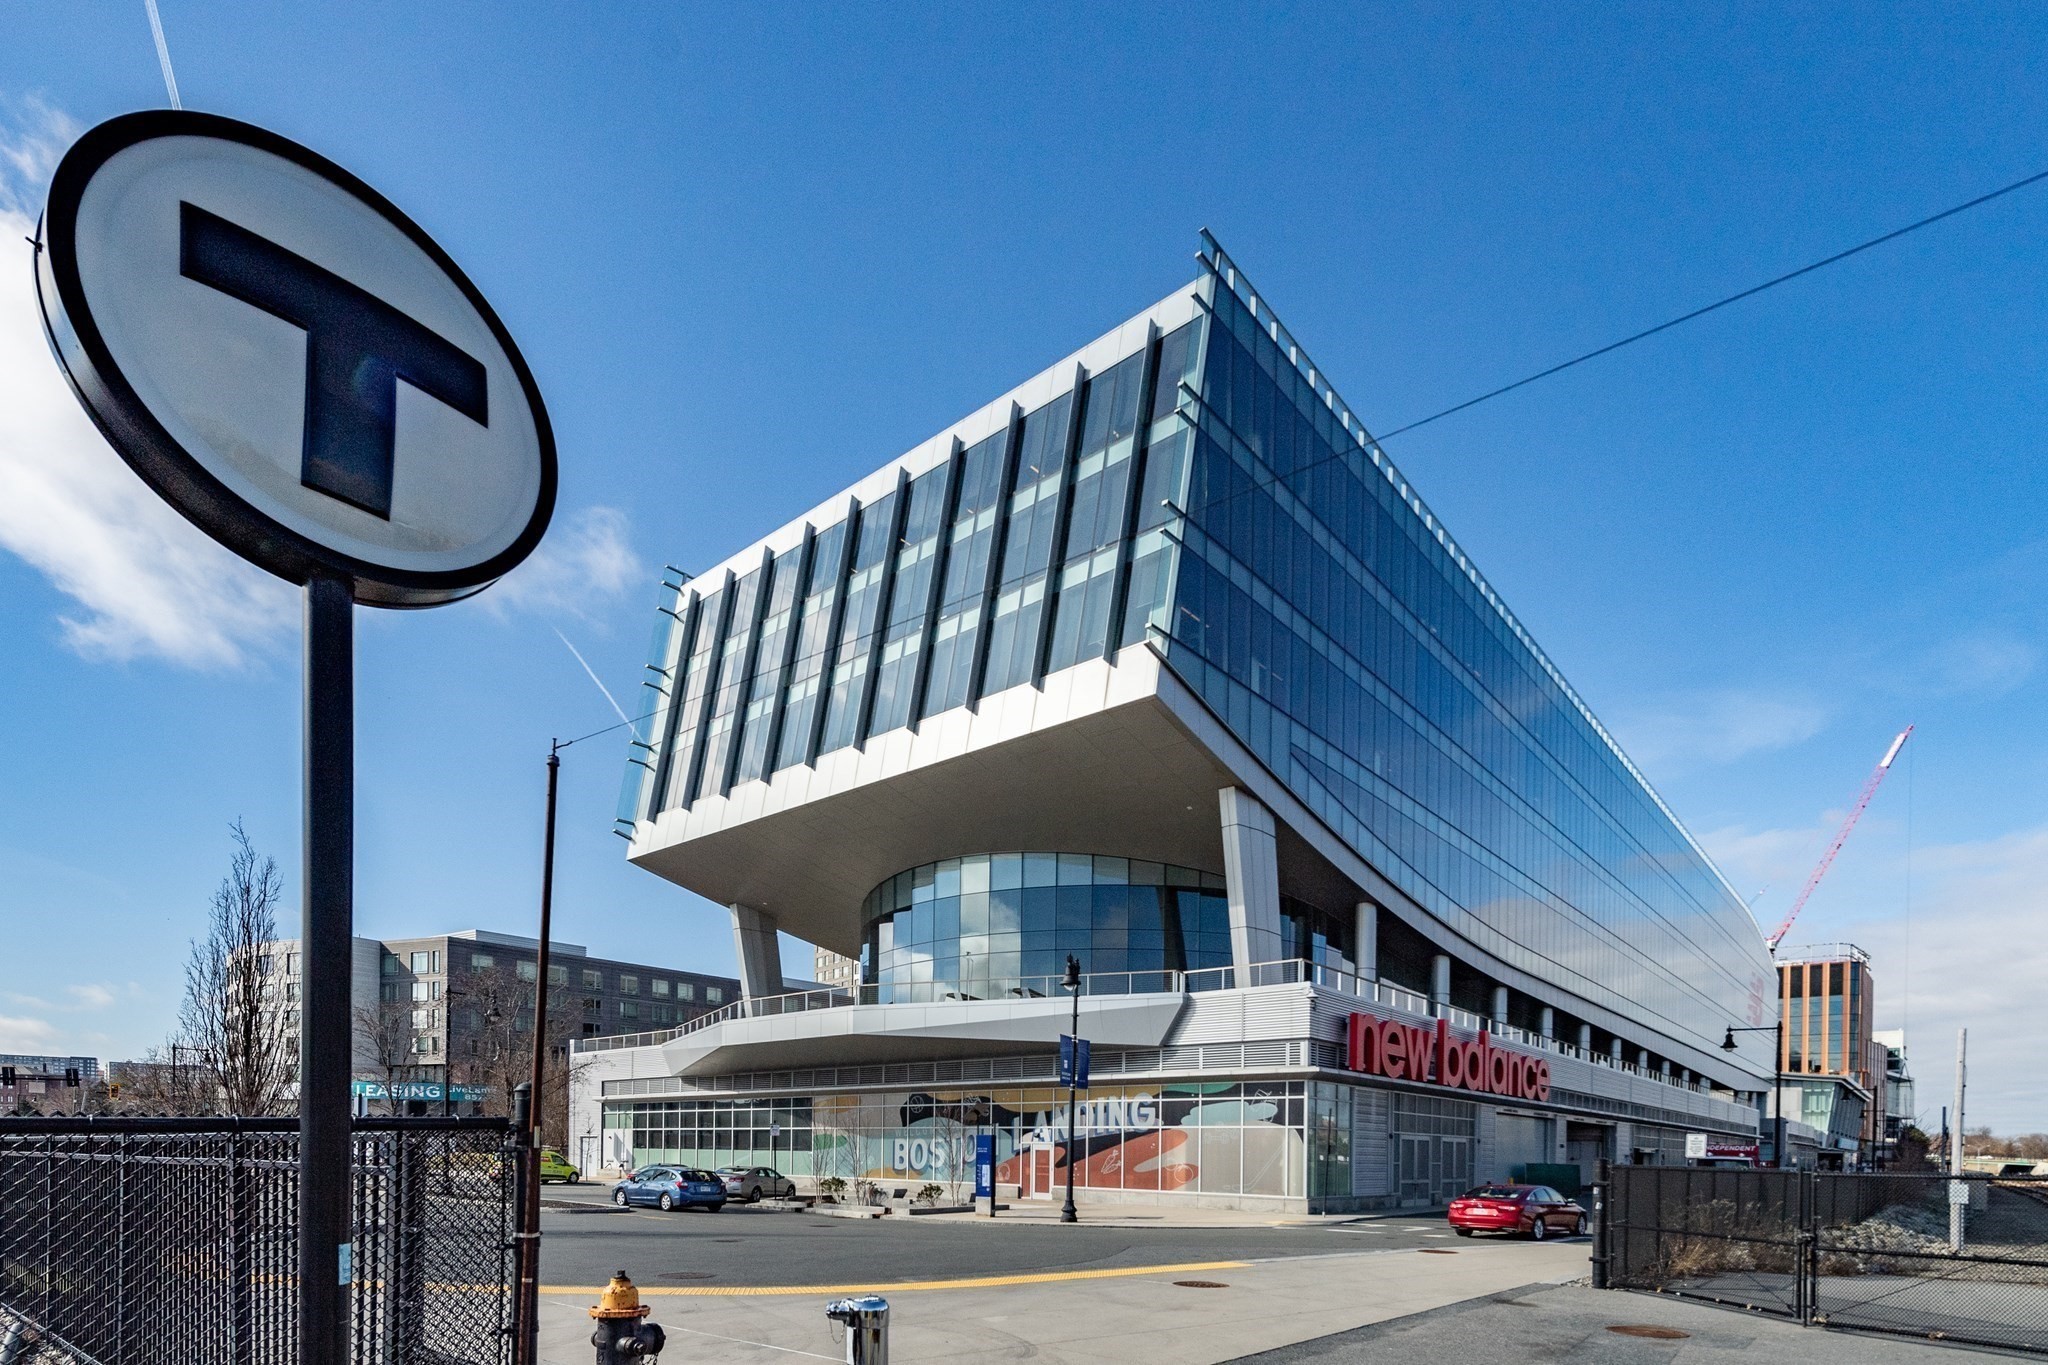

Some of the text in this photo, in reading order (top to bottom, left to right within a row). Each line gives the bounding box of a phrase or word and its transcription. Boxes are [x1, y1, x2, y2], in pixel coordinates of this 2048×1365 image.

[180, 200, 488, 522] T
[356, 1085, 440, 1098] LEASING
[1349, 1013, 1550, 1101] new balance
[1013, 1092, 1156, 1150] LANDING
